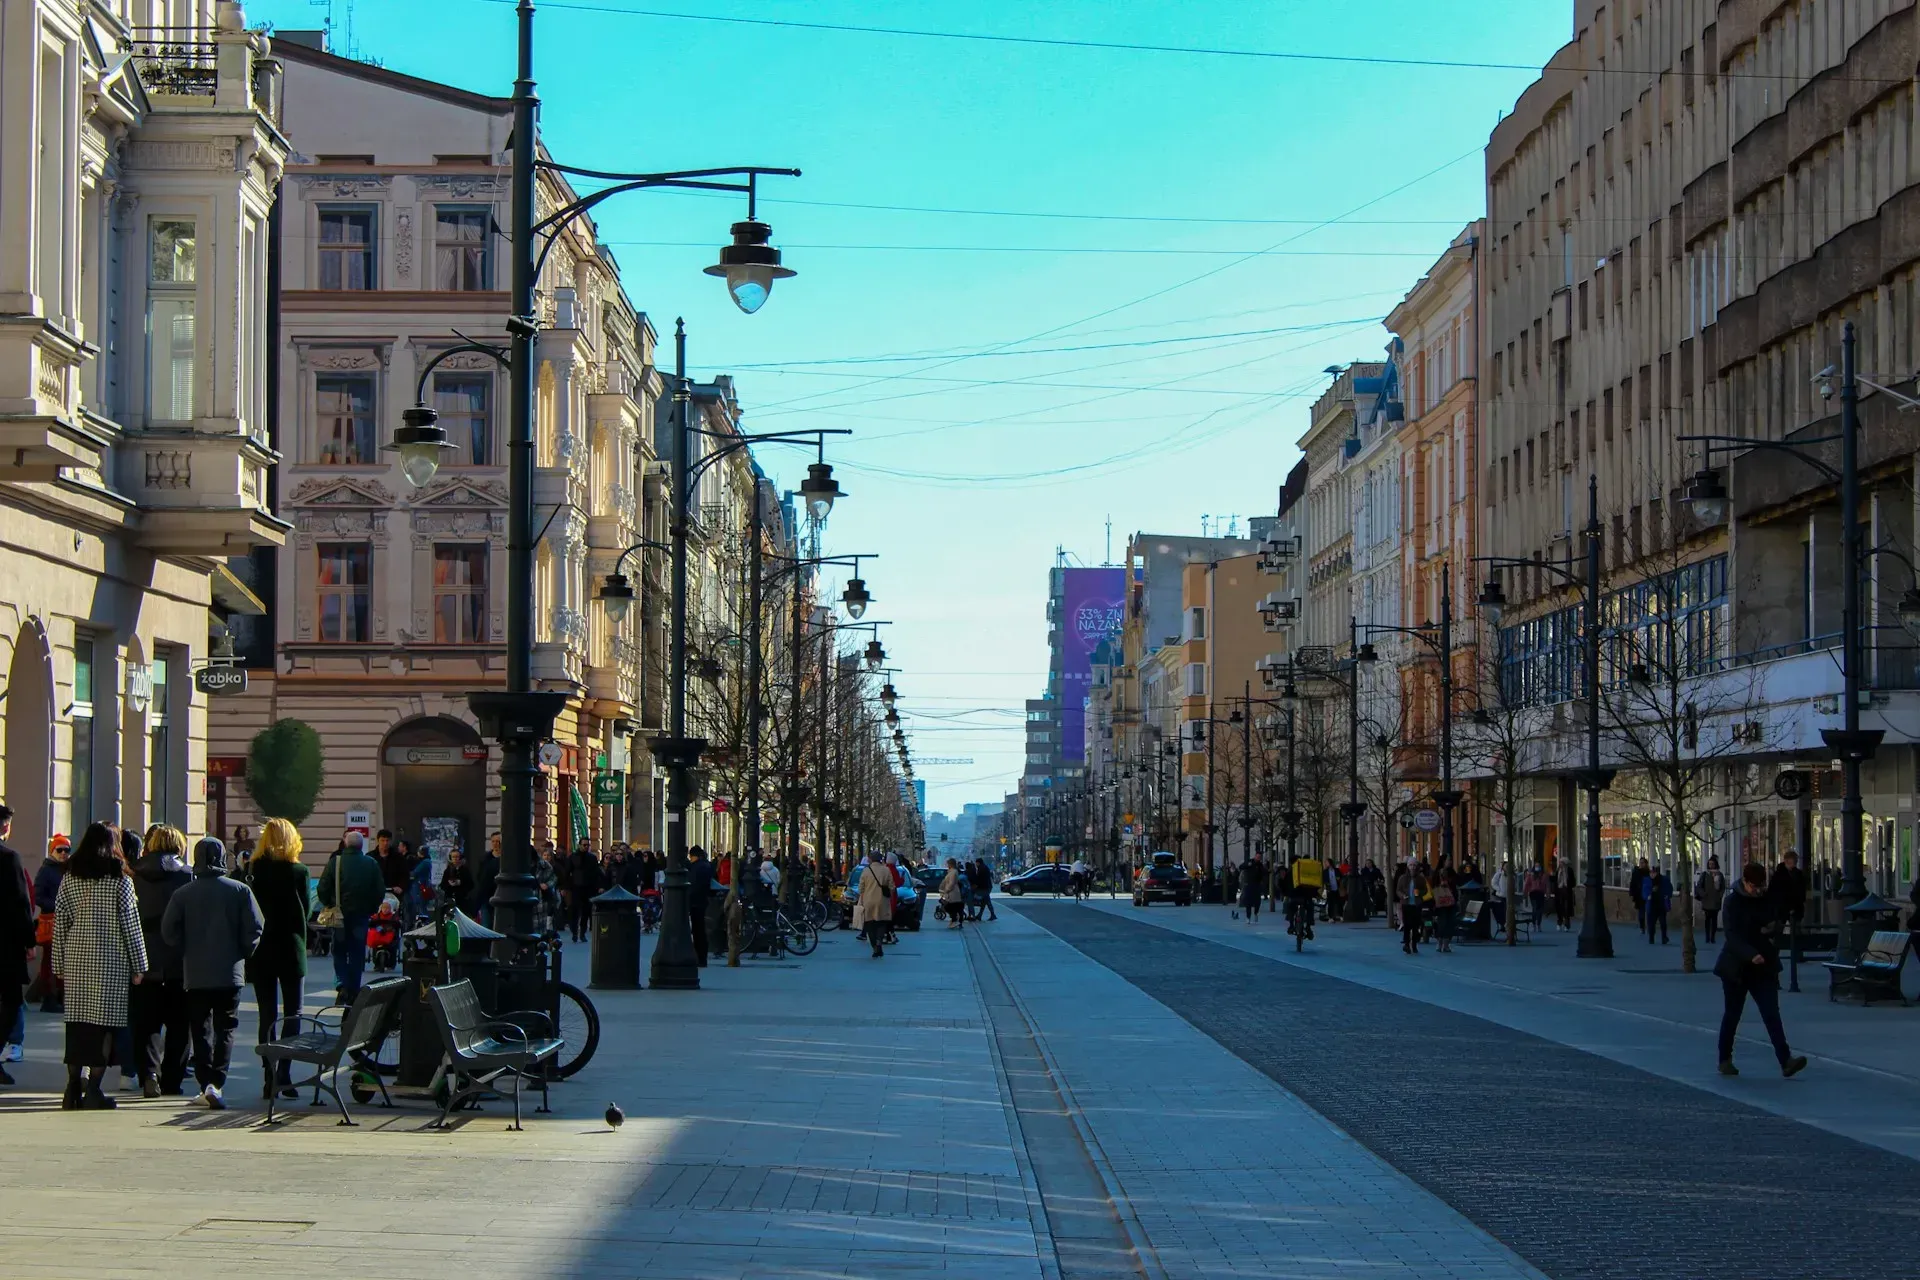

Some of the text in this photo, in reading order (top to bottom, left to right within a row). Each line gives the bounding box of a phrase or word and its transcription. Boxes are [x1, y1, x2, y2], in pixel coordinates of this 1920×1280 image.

[1079, 608, 1103, 620] 33%
[1078, 619, 1097, 631] NA
[200, 672, 242, 684] żabka
